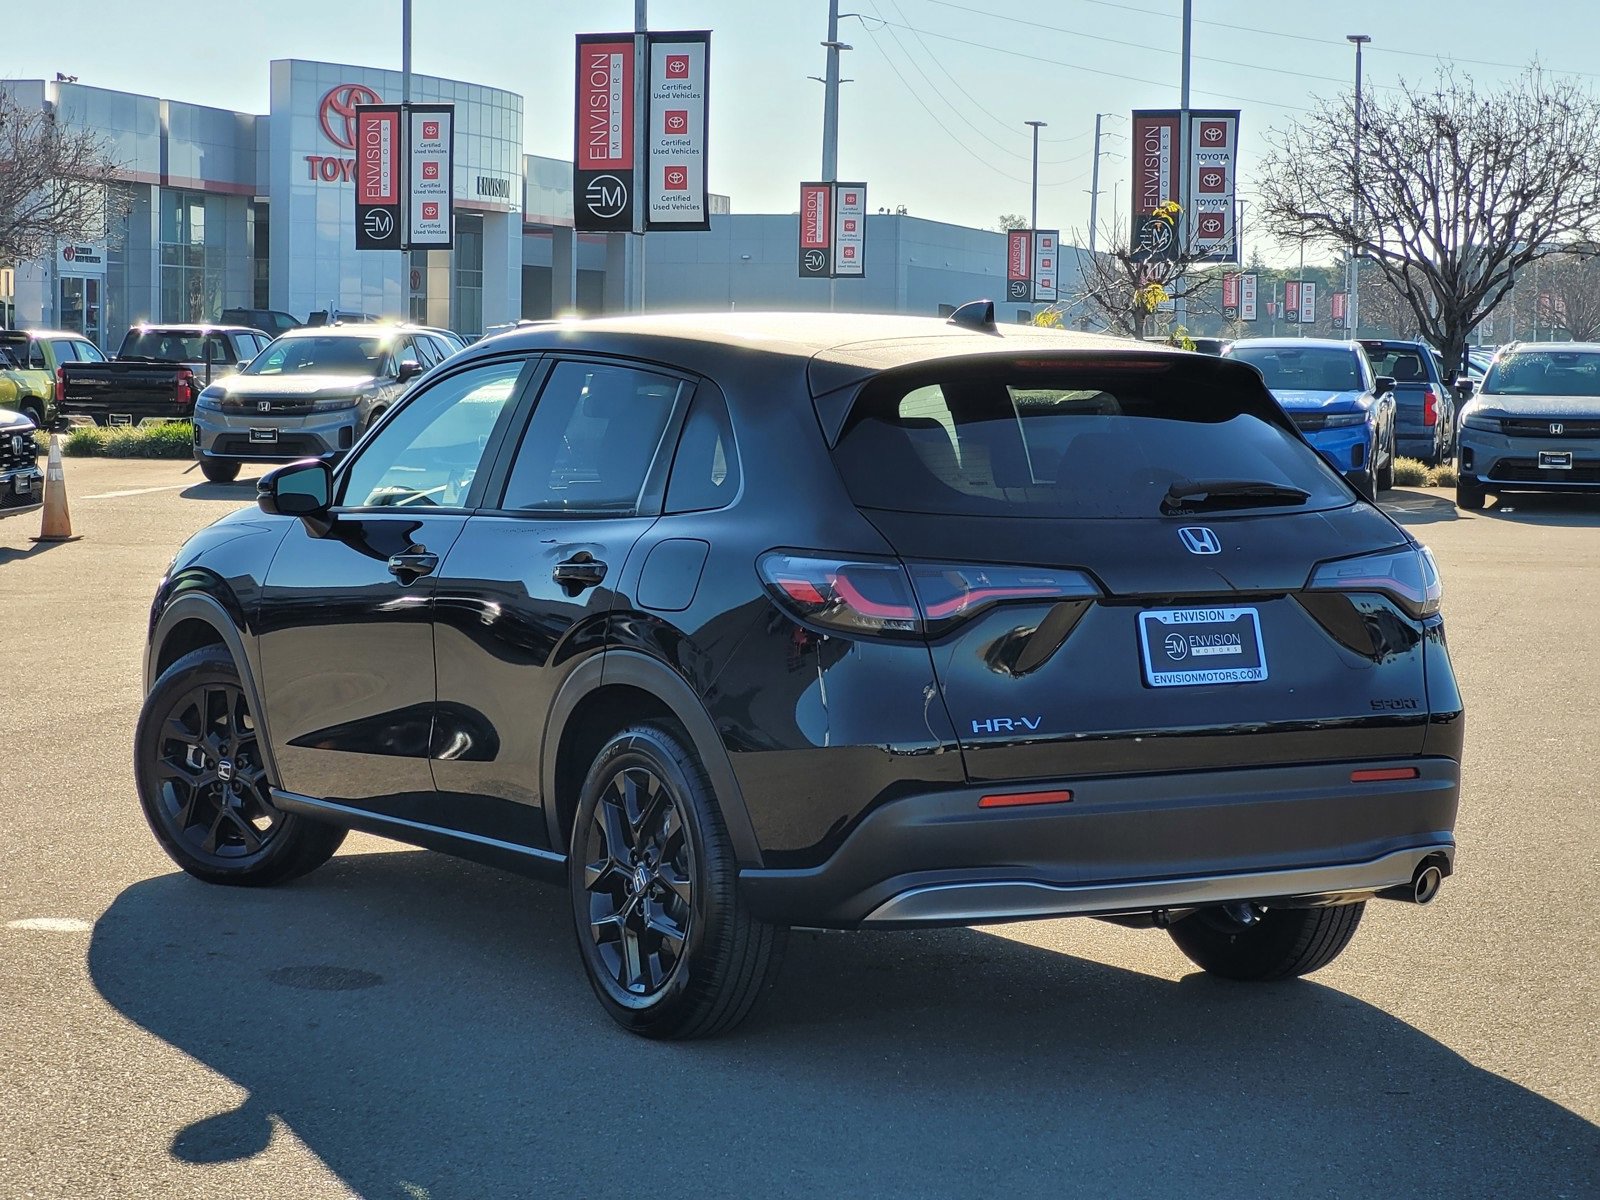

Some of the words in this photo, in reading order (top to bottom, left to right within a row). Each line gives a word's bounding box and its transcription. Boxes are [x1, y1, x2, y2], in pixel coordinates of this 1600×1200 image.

[589, 53, 609, 160] ENVISION
[611, 62, 621, 150] MOTORS
[366, 118, 380, 198] ENVISION
[653, 147, 670, 155] Used
[671, 147, 700, 155] Vehicles
[1195, 153, 1230, 161] TOYOTA
[306, 155, 357, 183] TOY
[1144, 126, 1160, 208] ENVISION
[653, 203, 670, 211] Used
[671, 203, 700, 211] Vehicles
[806, 191, 816, 243] ENVISION
[1173, 610, 1225, 623] ENVISION
[1188, 633, 1241, 647] ENVISION
[1153, 668, 1263, 684] ENVISIONMOTORS.COM
[1369, 698, 1420, 710] SPORT
[971, 716, 1042, 733] HR-V
